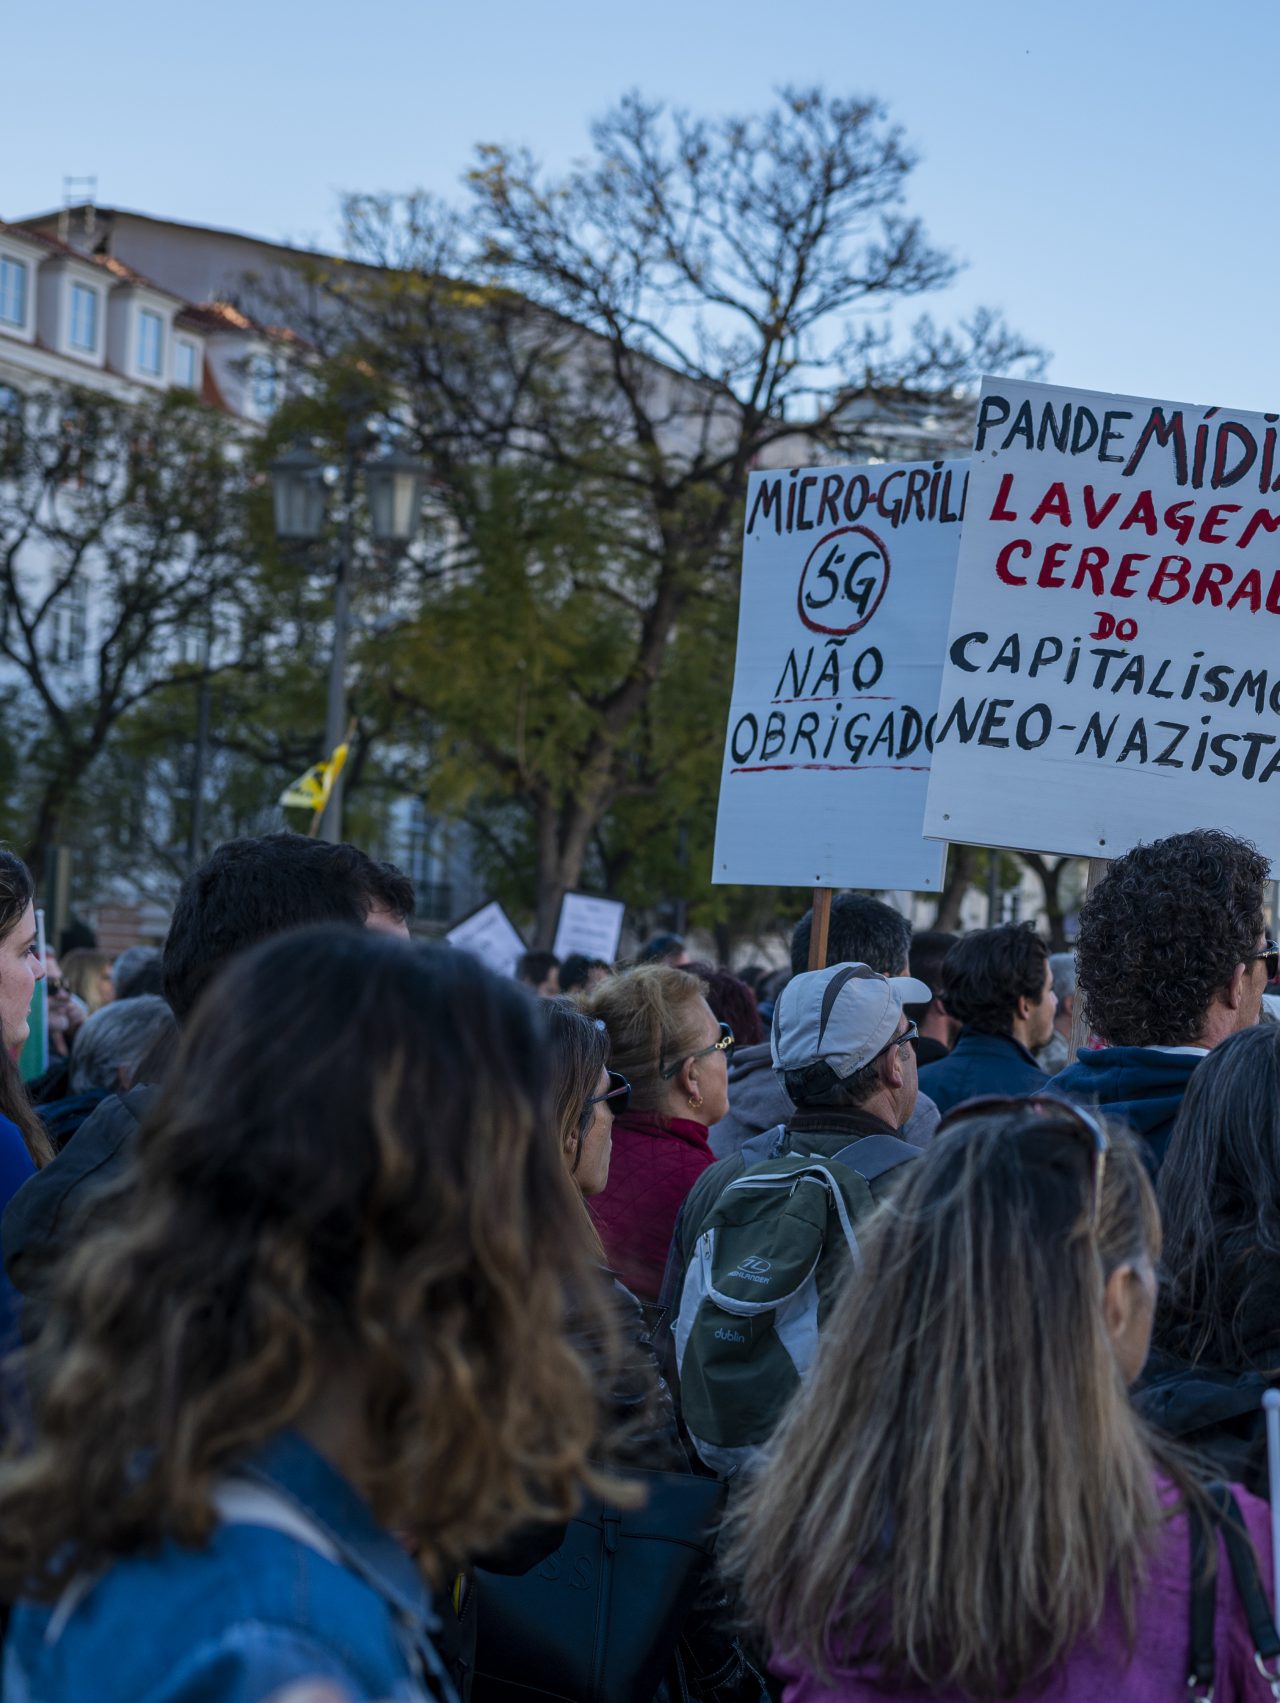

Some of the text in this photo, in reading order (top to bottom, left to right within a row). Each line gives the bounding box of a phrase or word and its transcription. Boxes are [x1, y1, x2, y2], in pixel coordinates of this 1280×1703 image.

[806, 544, 881, 618] 5G
[1089, 612, 1138, 641] DO
[774, 637, 884, 698] NÃO
[714, 1327, 745, 1344] dublin
